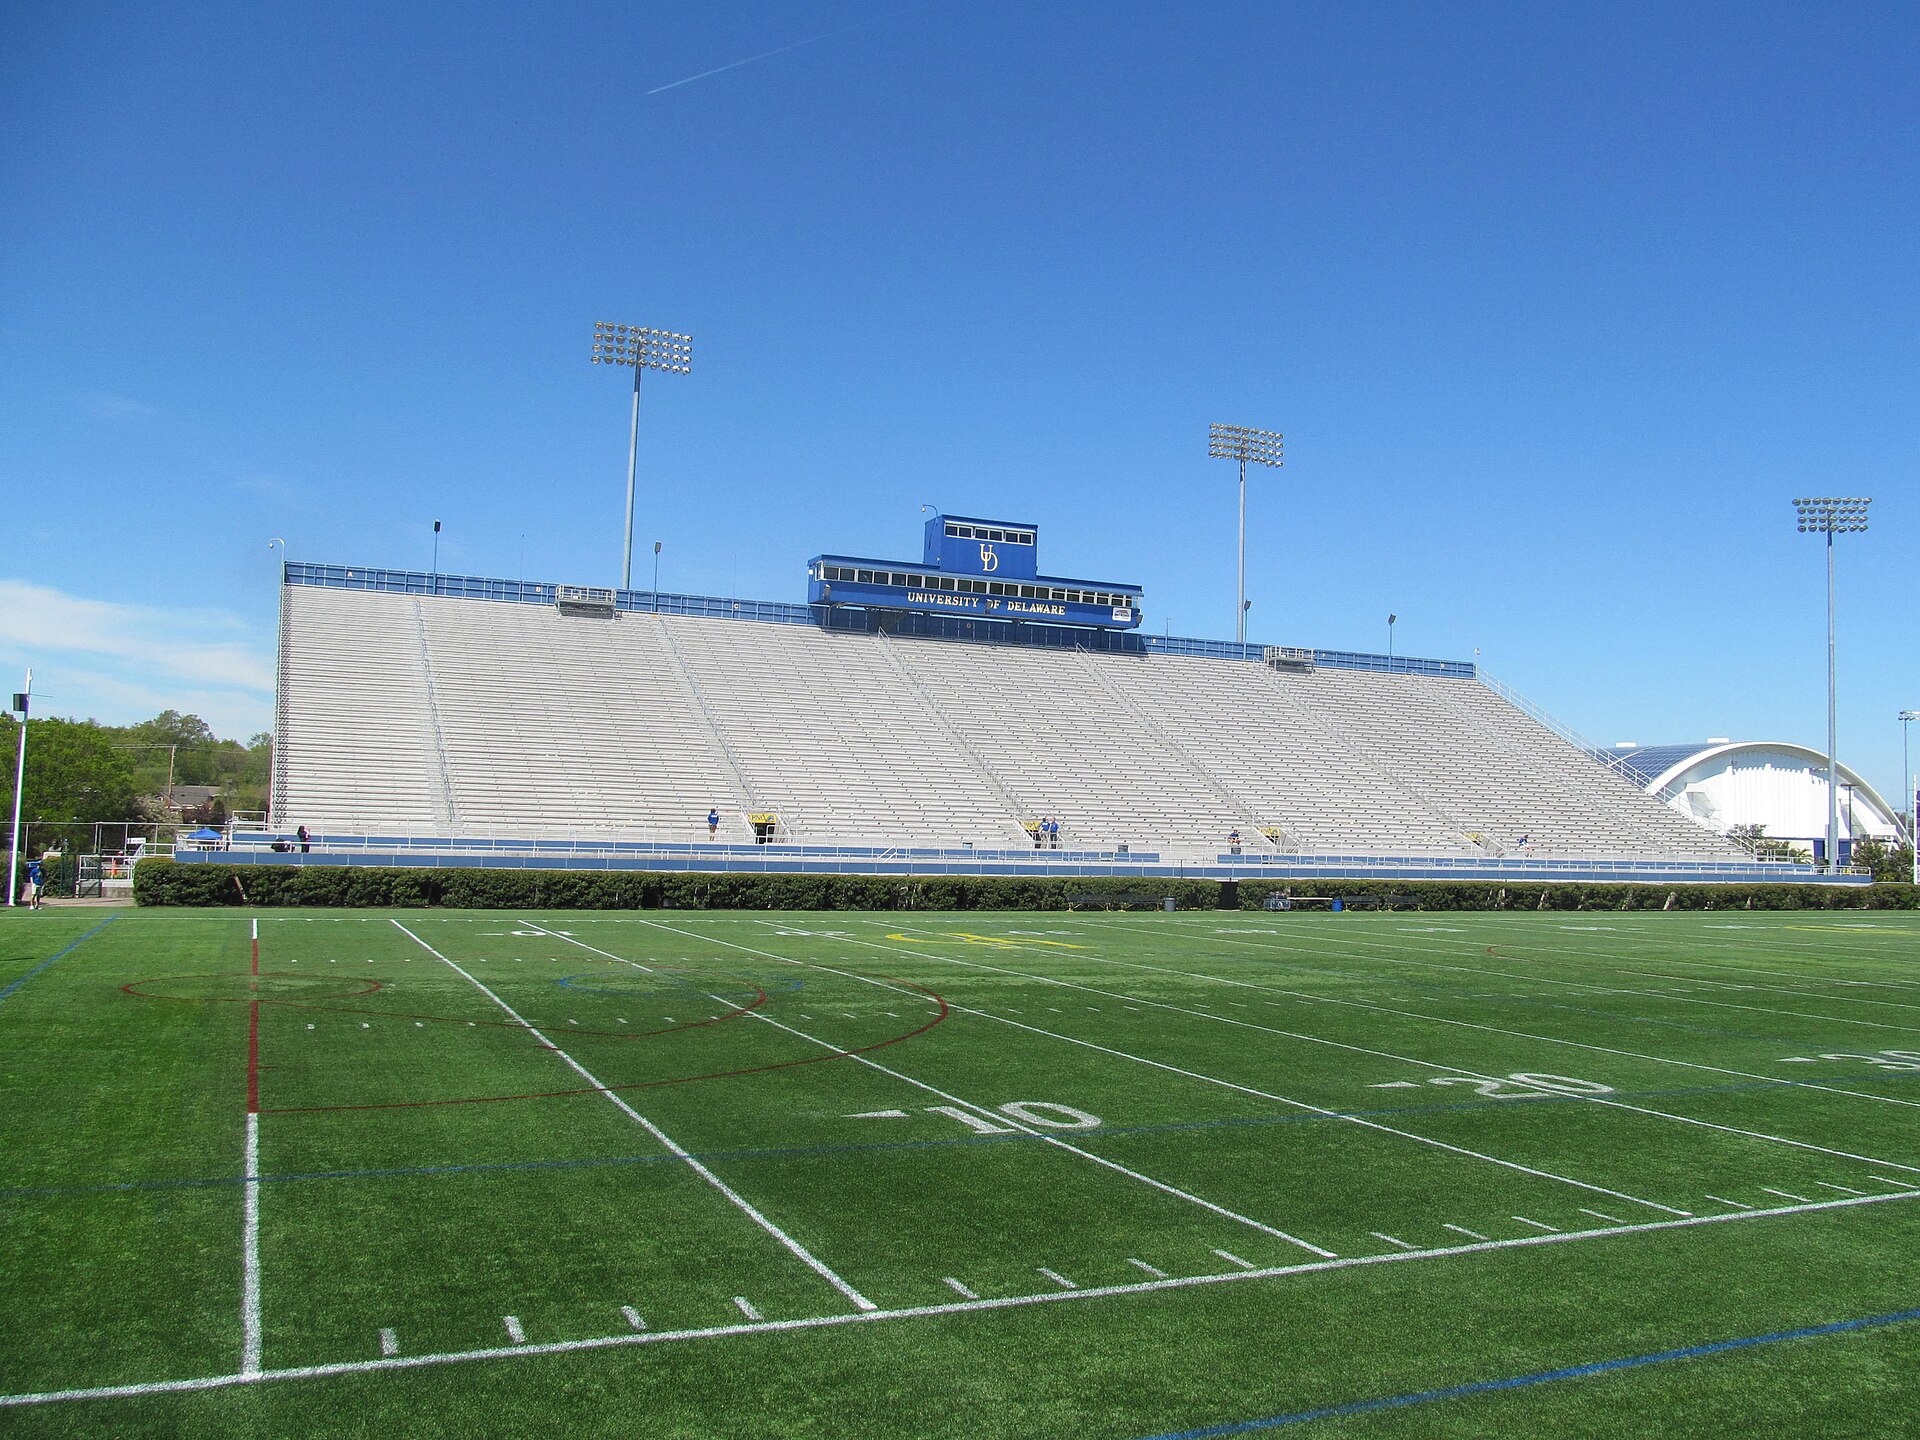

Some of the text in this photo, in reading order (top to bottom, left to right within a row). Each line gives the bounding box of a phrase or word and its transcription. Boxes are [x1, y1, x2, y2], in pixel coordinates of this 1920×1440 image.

[980, 543, 999, 572] UD
[907, 591, 979, 608] UNIVERSITY
[1007, 601, 1066, 616] DELAWARE
[1426, 1072, 1615, 1100] 20
[923, 1101, 1102, 1135] 10
